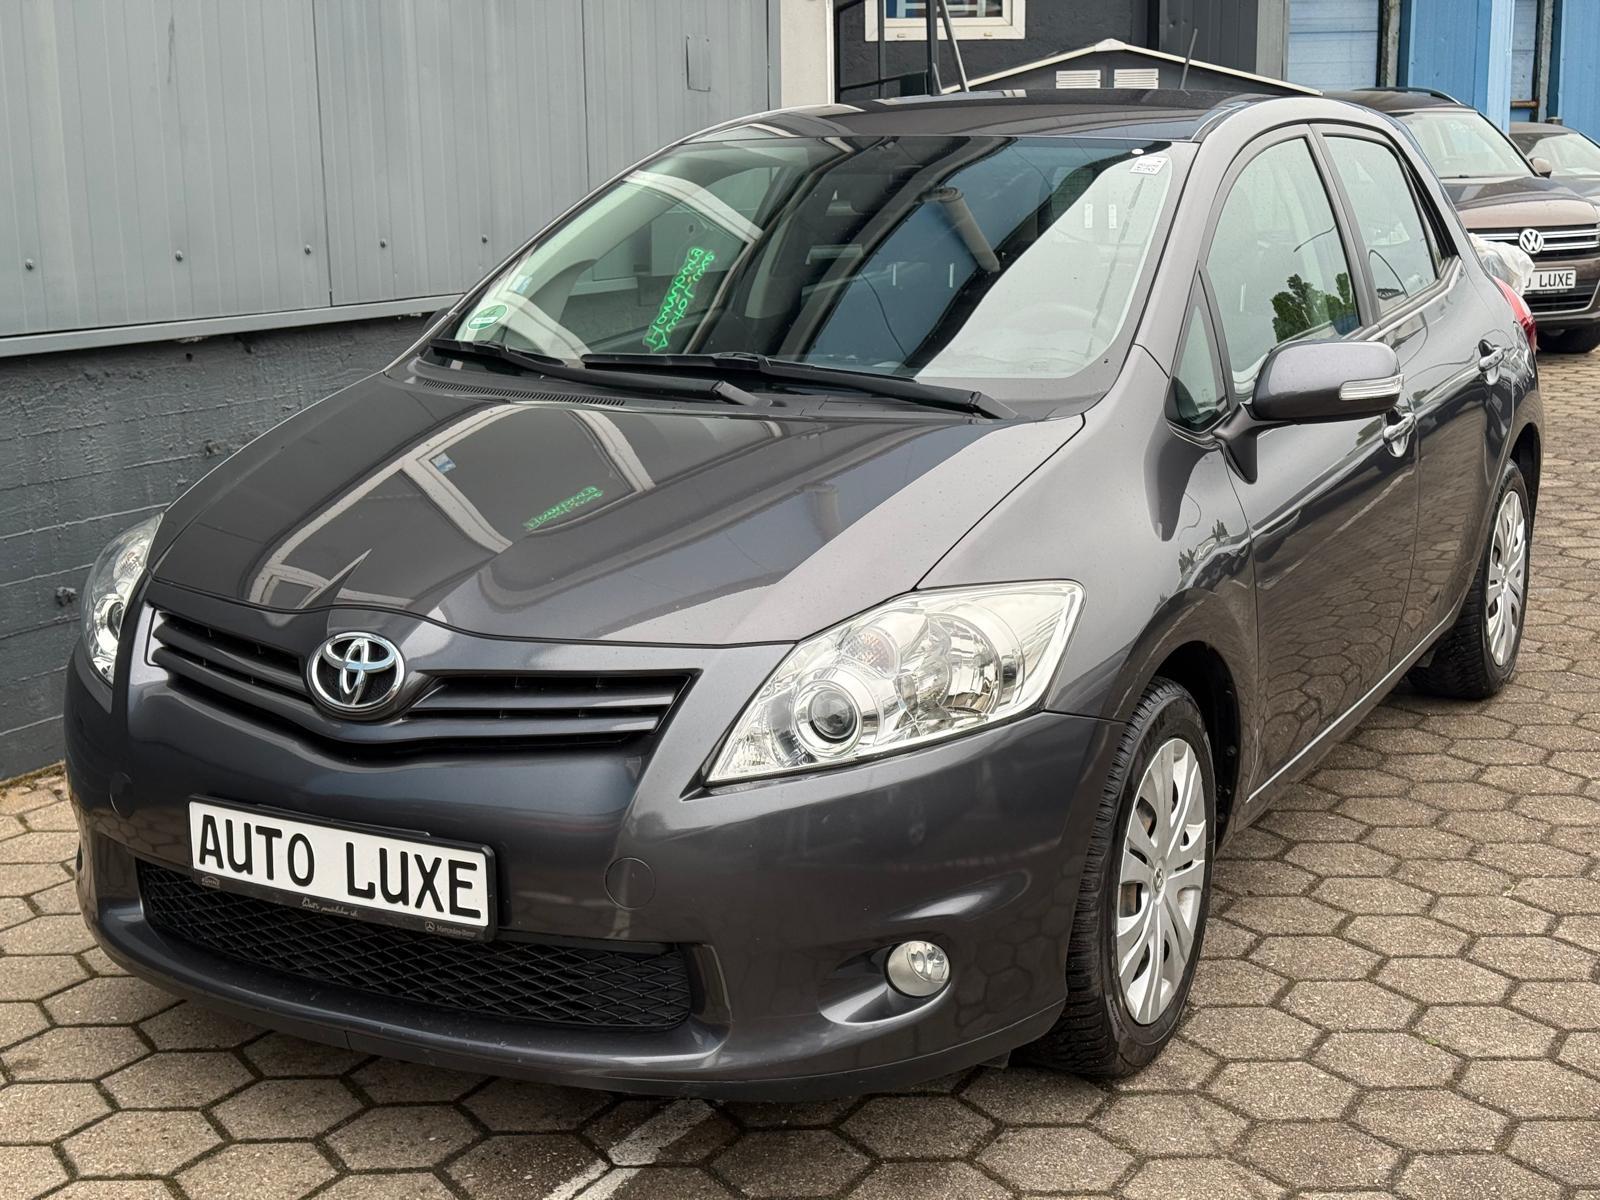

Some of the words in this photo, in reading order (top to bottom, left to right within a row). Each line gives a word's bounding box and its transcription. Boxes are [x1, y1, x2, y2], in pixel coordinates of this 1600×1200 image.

[1540, 273, 1573, 287] LUXE
[199, 813, 315, 887] AUTO
[345, 841, 481, 919] LUXE
